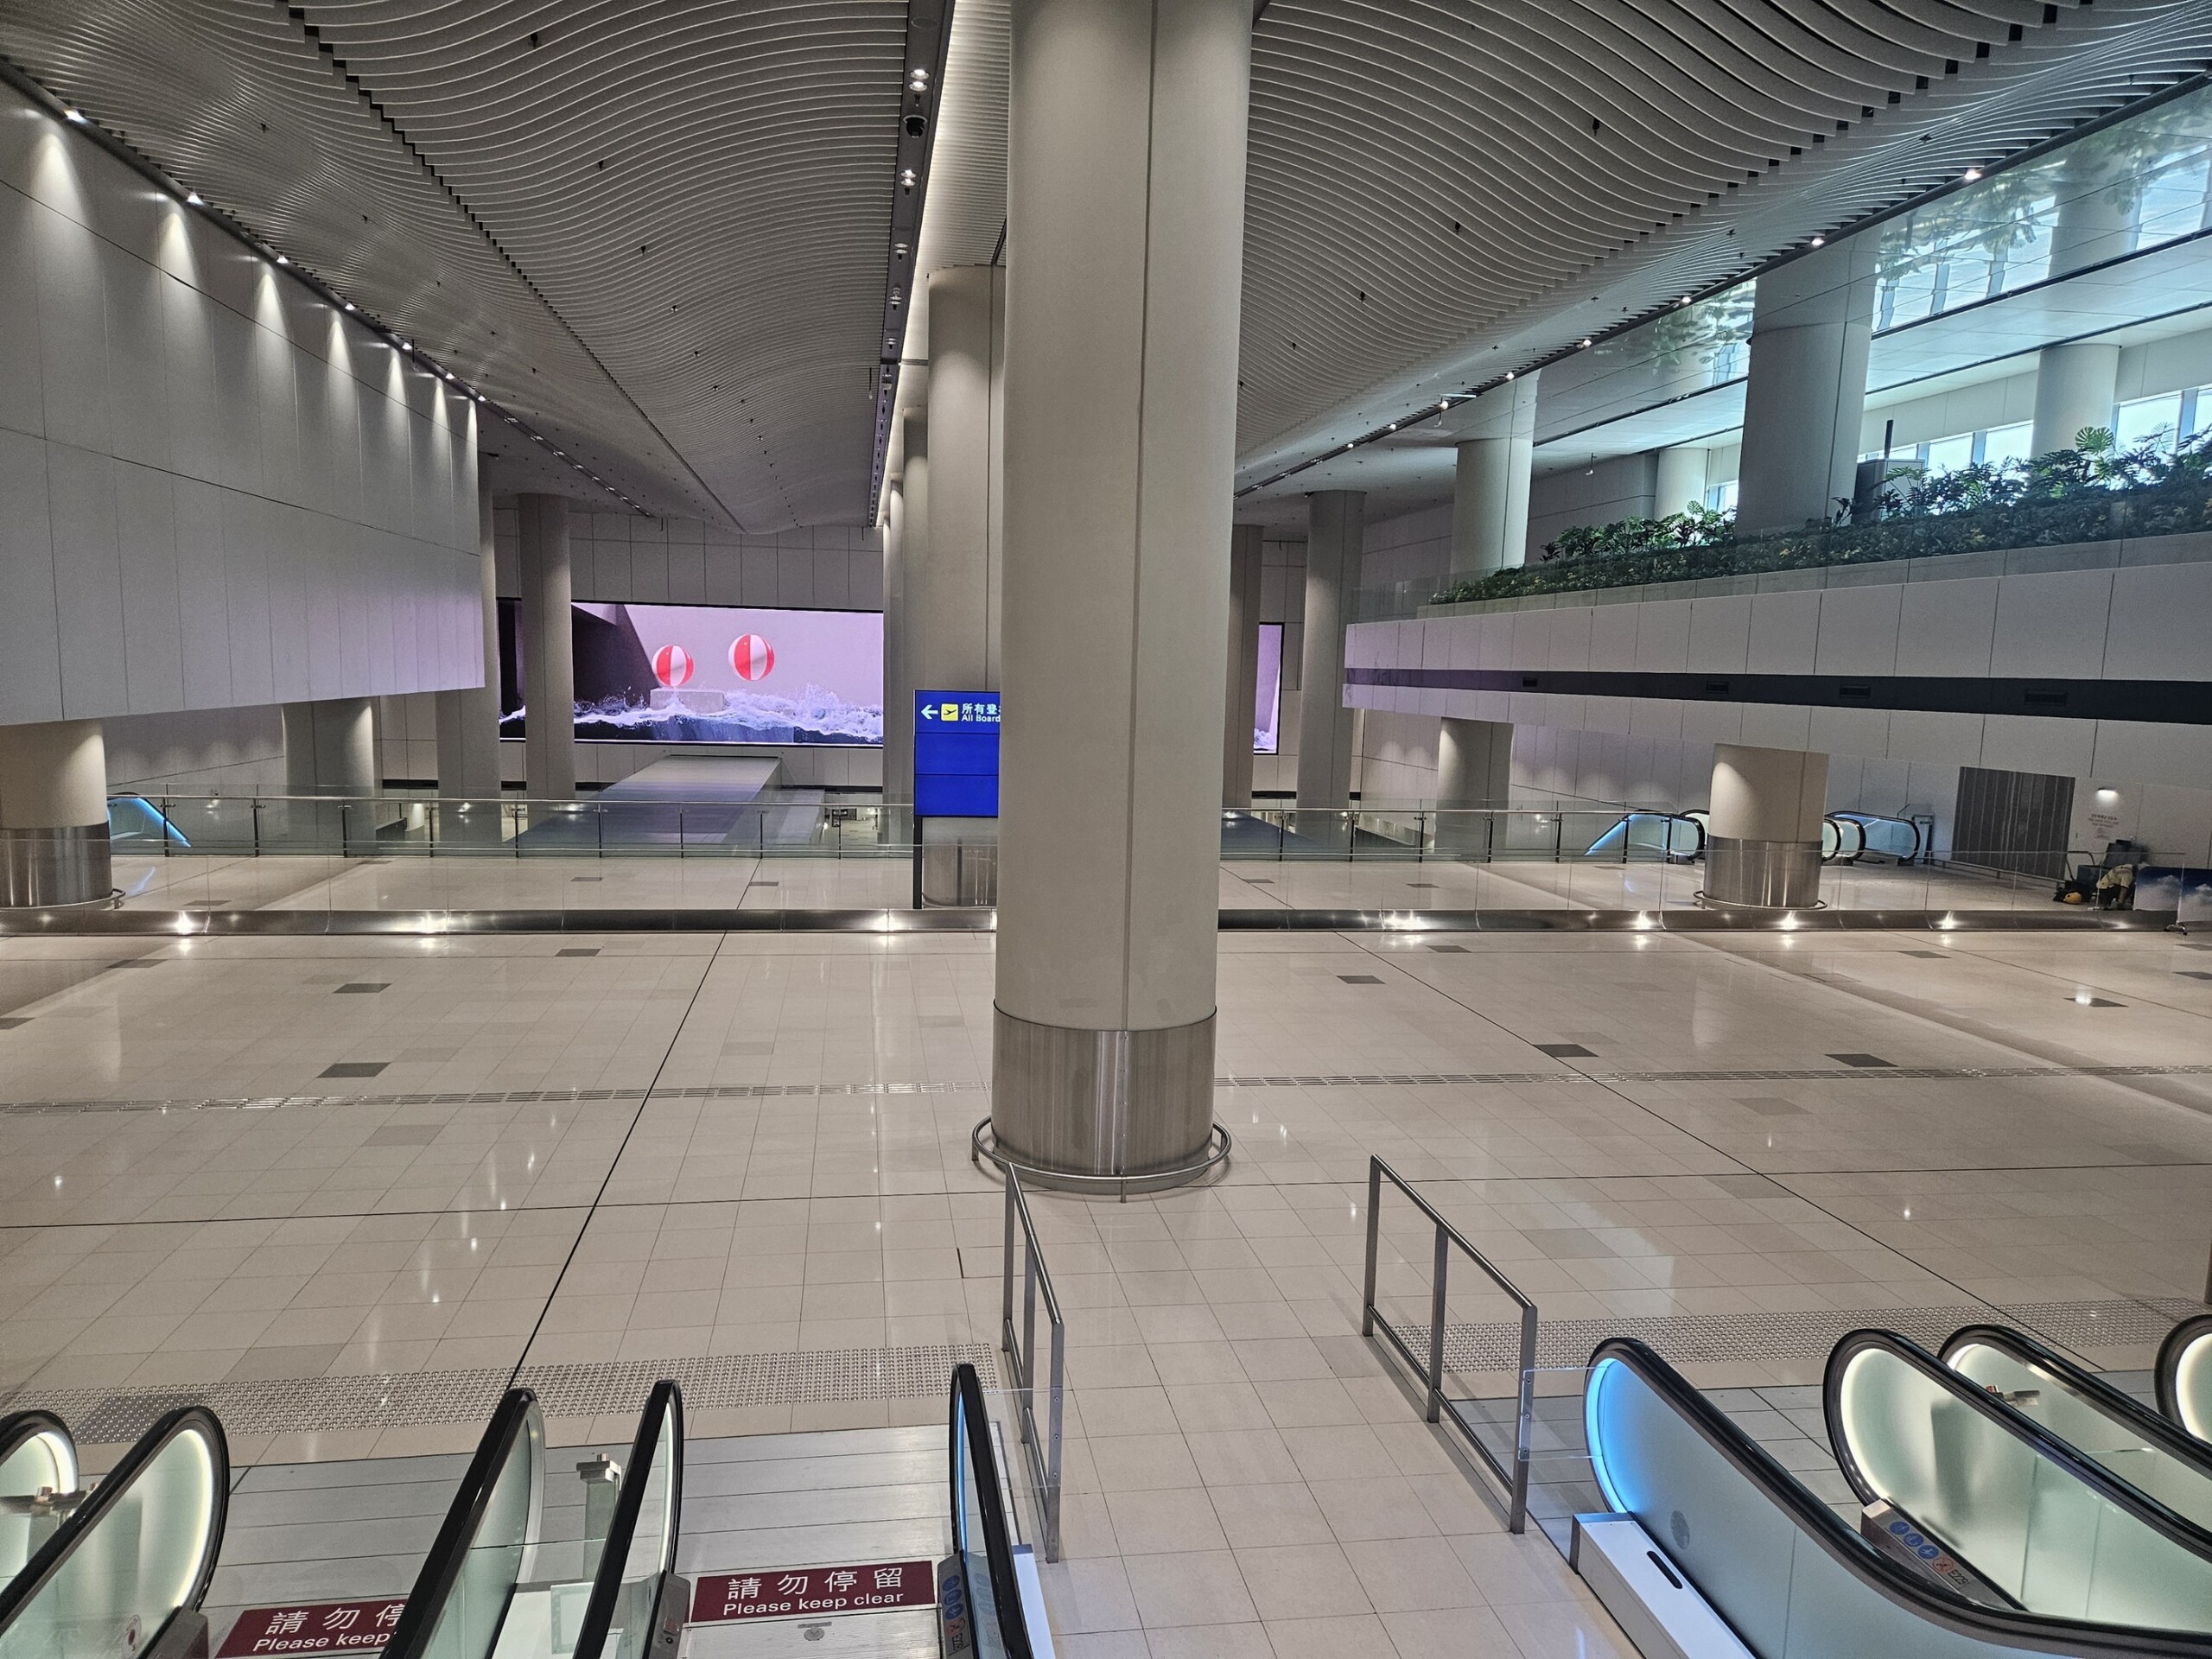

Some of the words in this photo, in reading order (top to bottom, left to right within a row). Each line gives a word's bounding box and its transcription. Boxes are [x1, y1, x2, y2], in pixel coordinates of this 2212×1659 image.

[961, 702, 1001, 715] 所有登
[961, 714, 973, 722] All
[976, 714, 1001, 722] Board
[728, 1567, 903, 1599] 請勿停留
[722, 1601, 791, 1616] Please
[798, 1599, 847, 1610] keep
[854, 1592, 904, 1605] clear
[252, 1637, 329, 1651] Please
[335, 1633, 391, 1646] keep
